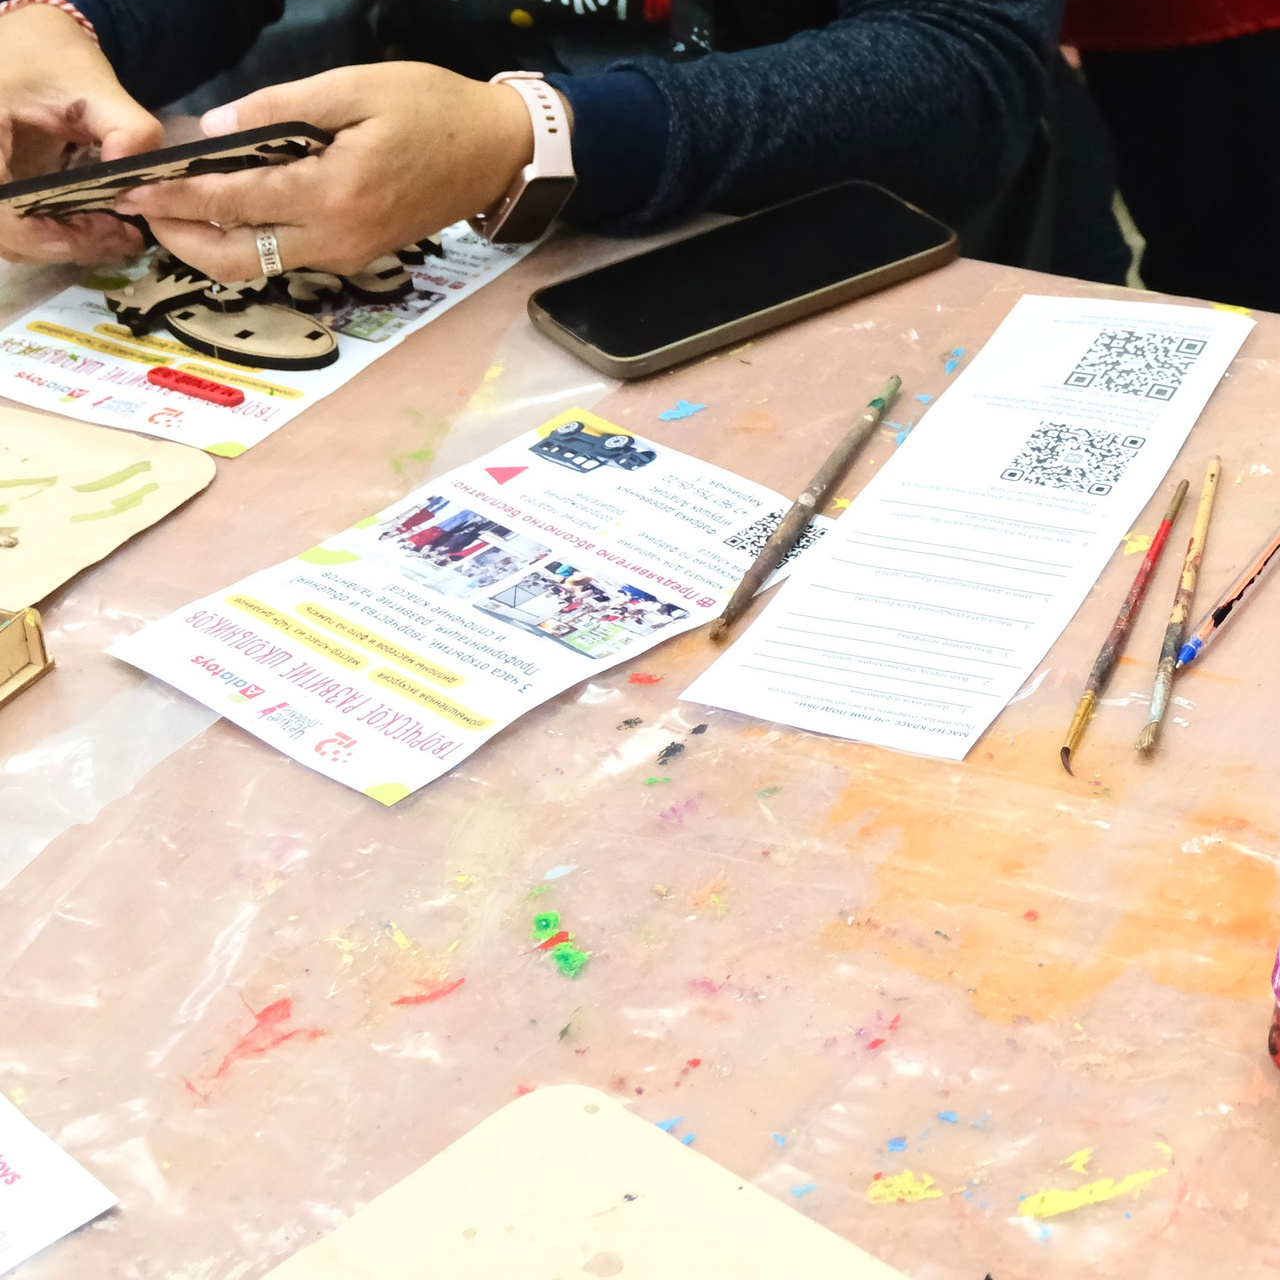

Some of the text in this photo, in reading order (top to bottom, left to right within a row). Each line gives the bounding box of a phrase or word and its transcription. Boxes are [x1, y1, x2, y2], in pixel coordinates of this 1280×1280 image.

[542, 489, 614, 521] сопровождение
[575, 492, 626, 516] родителей
[651, 485, 733, 527] игрушек Алатойс
[661, 473, 748, 515] +7 967 755-05-22
[519, 493, 599, 532] участие педагога
[616, 485, 717, 535] Фабрика деревянных
[452, 481, 700, 600] Предъявителю абсолютно бесплатно:
[636, 531, 679, 553] фабрике
[616, 538, 724, 590] комната для чаепития
[677, 550, 693, 560] по
[697, 547, 732, 566] класса
[289, 577, 350, 602] общения!
[320, 571, 375, 598] талантов
[305, 606, 336, 625] память
[348, 599, 361, 607] и
[374, 595, 436, 626] развитие
[381, 584, 507, 642] и сплочение класса!
[233, 597, 361, 666] мастер-класс из 140+ дизайнов
[334, 621, 348, 631] на
[346, 628, 369, 641] фото
[359, 604, 426, 642] творчества
[375, 642, 416, 665] мастеров
[189, 654, 248, 688] alatoys
[376, 672, 420, 695] экскурсия
[414, 661, 458, 684] дипломы
[489, 667, 519, 685] часа
[184, 609, 464, 761] ТВОРЧЕСКОЕ РАЗВИТИЕ ШКОЛЬНИКОВ
[517, 682, 533, 694] 3
[894, 720, 970, 738] МАСТЕР-КЛАСС
